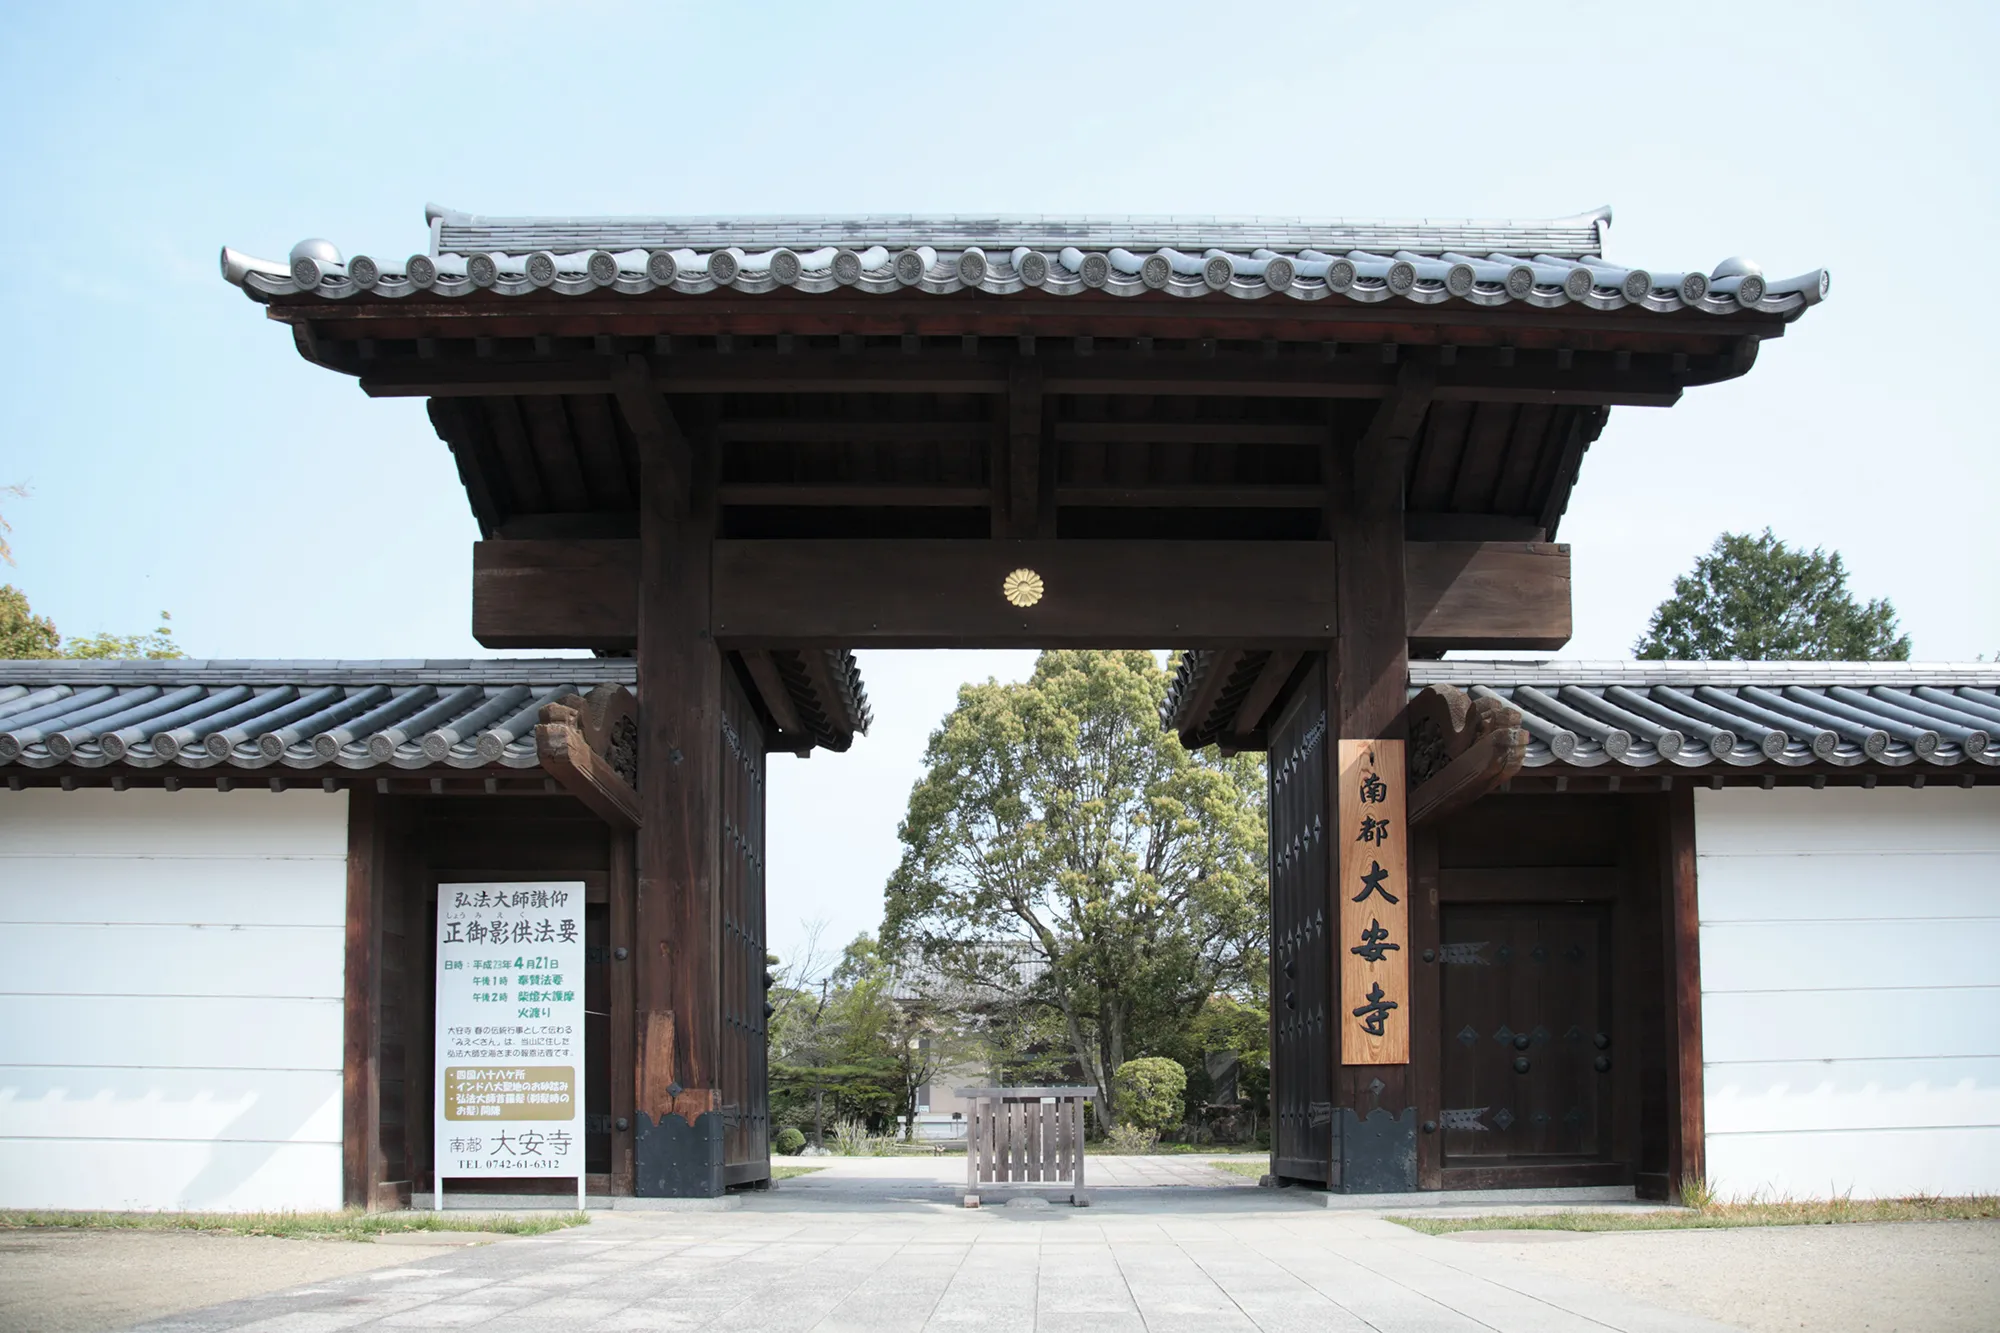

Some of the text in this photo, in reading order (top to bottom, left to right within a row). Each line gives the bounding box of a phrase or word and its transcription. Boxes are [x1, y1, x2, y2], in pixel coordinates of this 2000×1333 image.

[1350, 772, 1400, 1037] 南都大安寺
[443, 919, 579, 945] 正御影供法要
[472, 976, 508, 986] 午後1時
[472, 993, 508, 1003] 午後2時
[518, 1007, 551, 1019] 火渡り
[449, 1129, 573, 1156] 南都 大安寺
[457, 1160, 560, 1169] TEL 0742-61-6312
